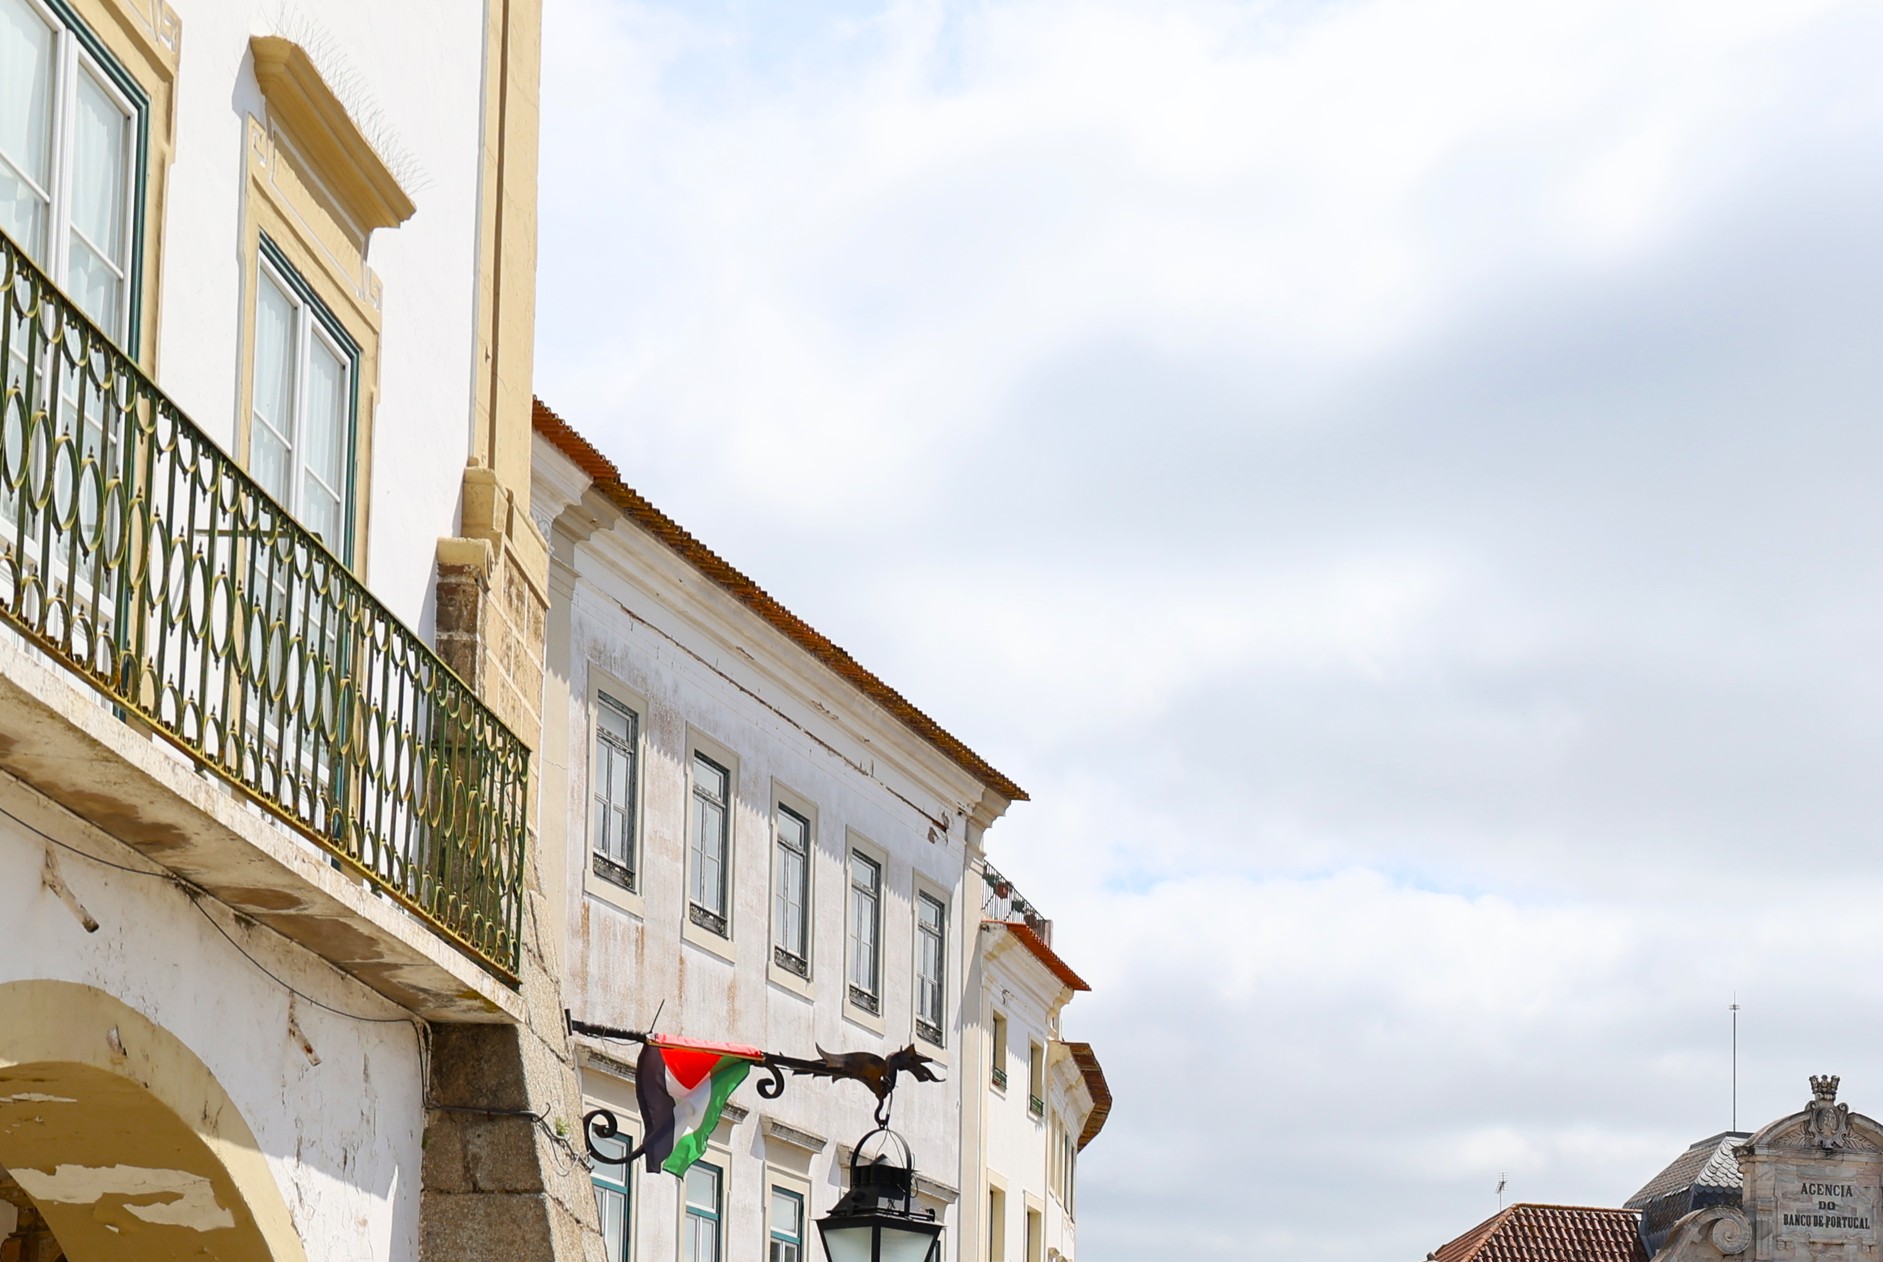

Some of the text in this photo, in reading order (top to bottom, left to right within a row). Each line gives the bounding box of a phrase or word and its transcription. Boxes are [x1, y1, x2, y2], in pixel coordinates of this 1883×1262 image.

[1800, 1183, 1853, 1197] AGENCIA
[1818, 1201, 1836, 1211] DO
[1783, 1214, 1870, 1230] BANCO DE PORTUGAL
